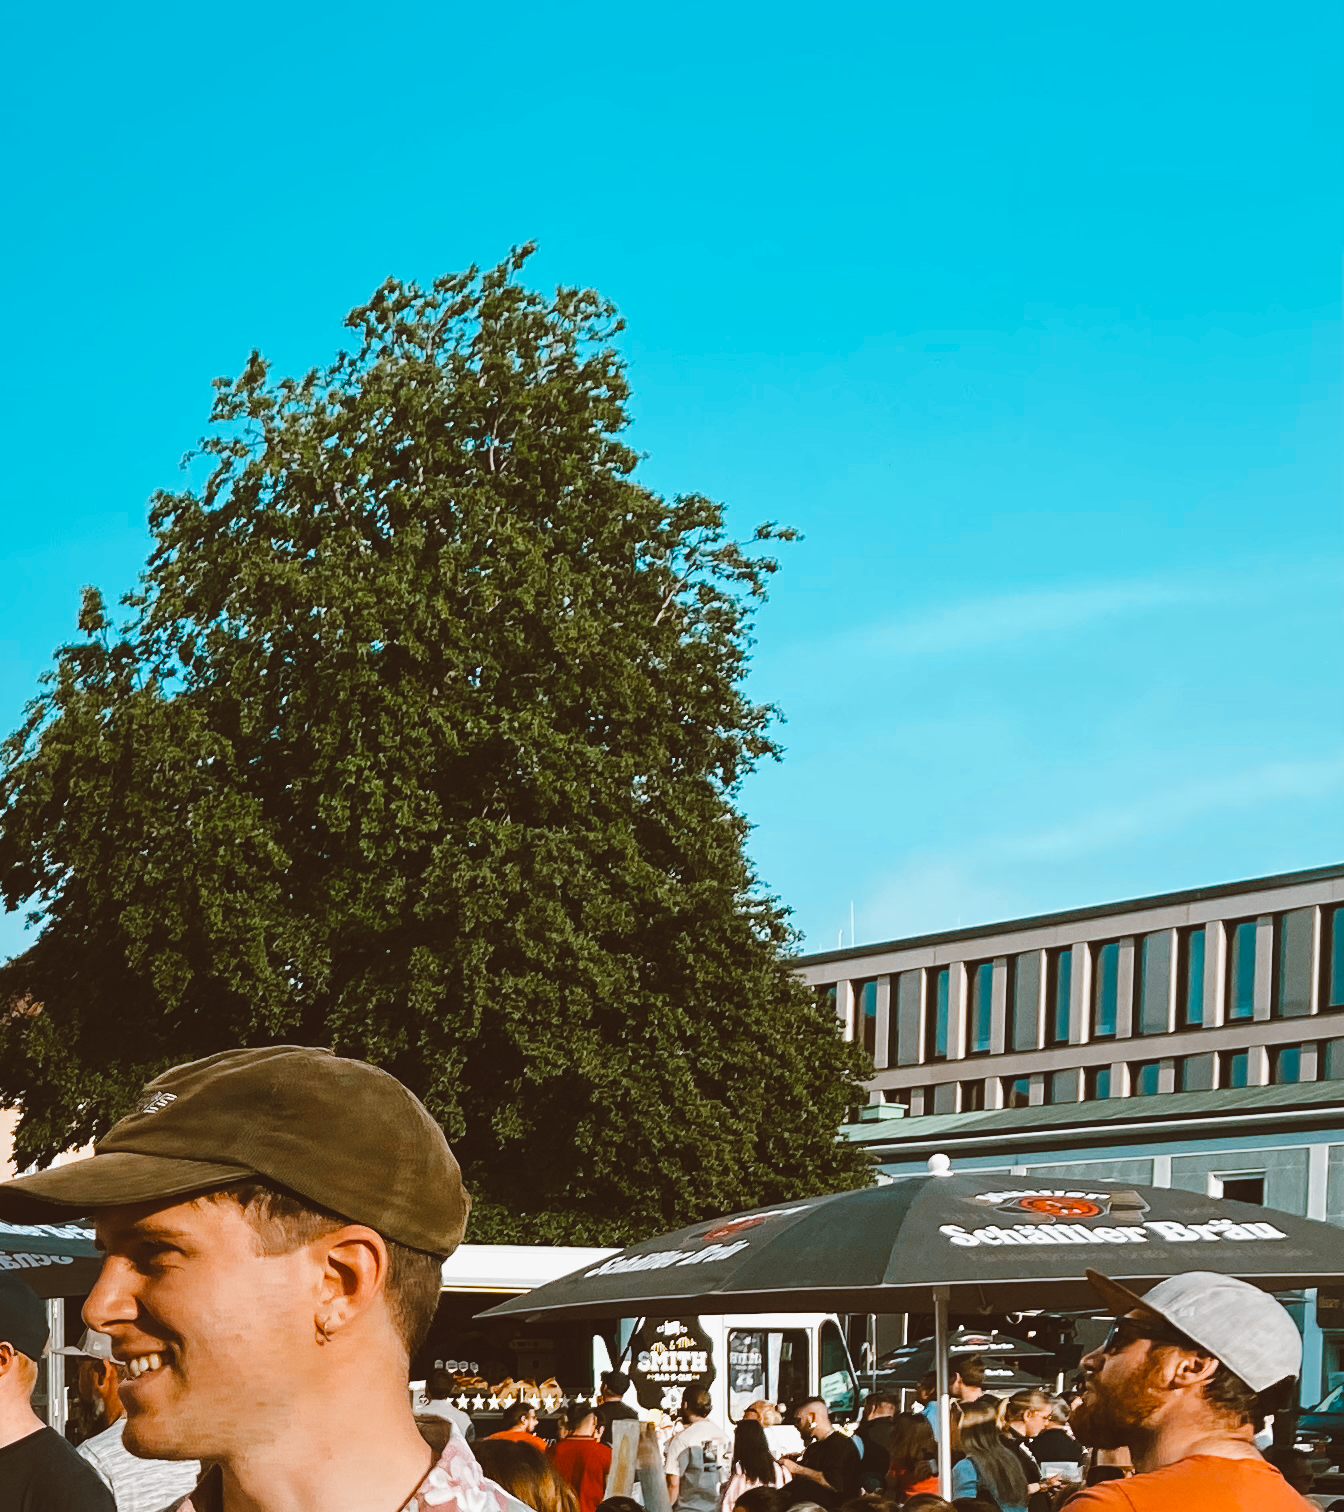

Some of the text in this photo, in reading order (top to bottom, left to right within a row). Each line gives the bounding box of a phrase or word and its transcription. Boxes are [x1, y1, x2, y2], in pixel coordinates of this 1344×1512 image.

[938, 1218, 1290, 1248] Schäffler Bräu
[637, 1350, 708, 1373] SMITH
